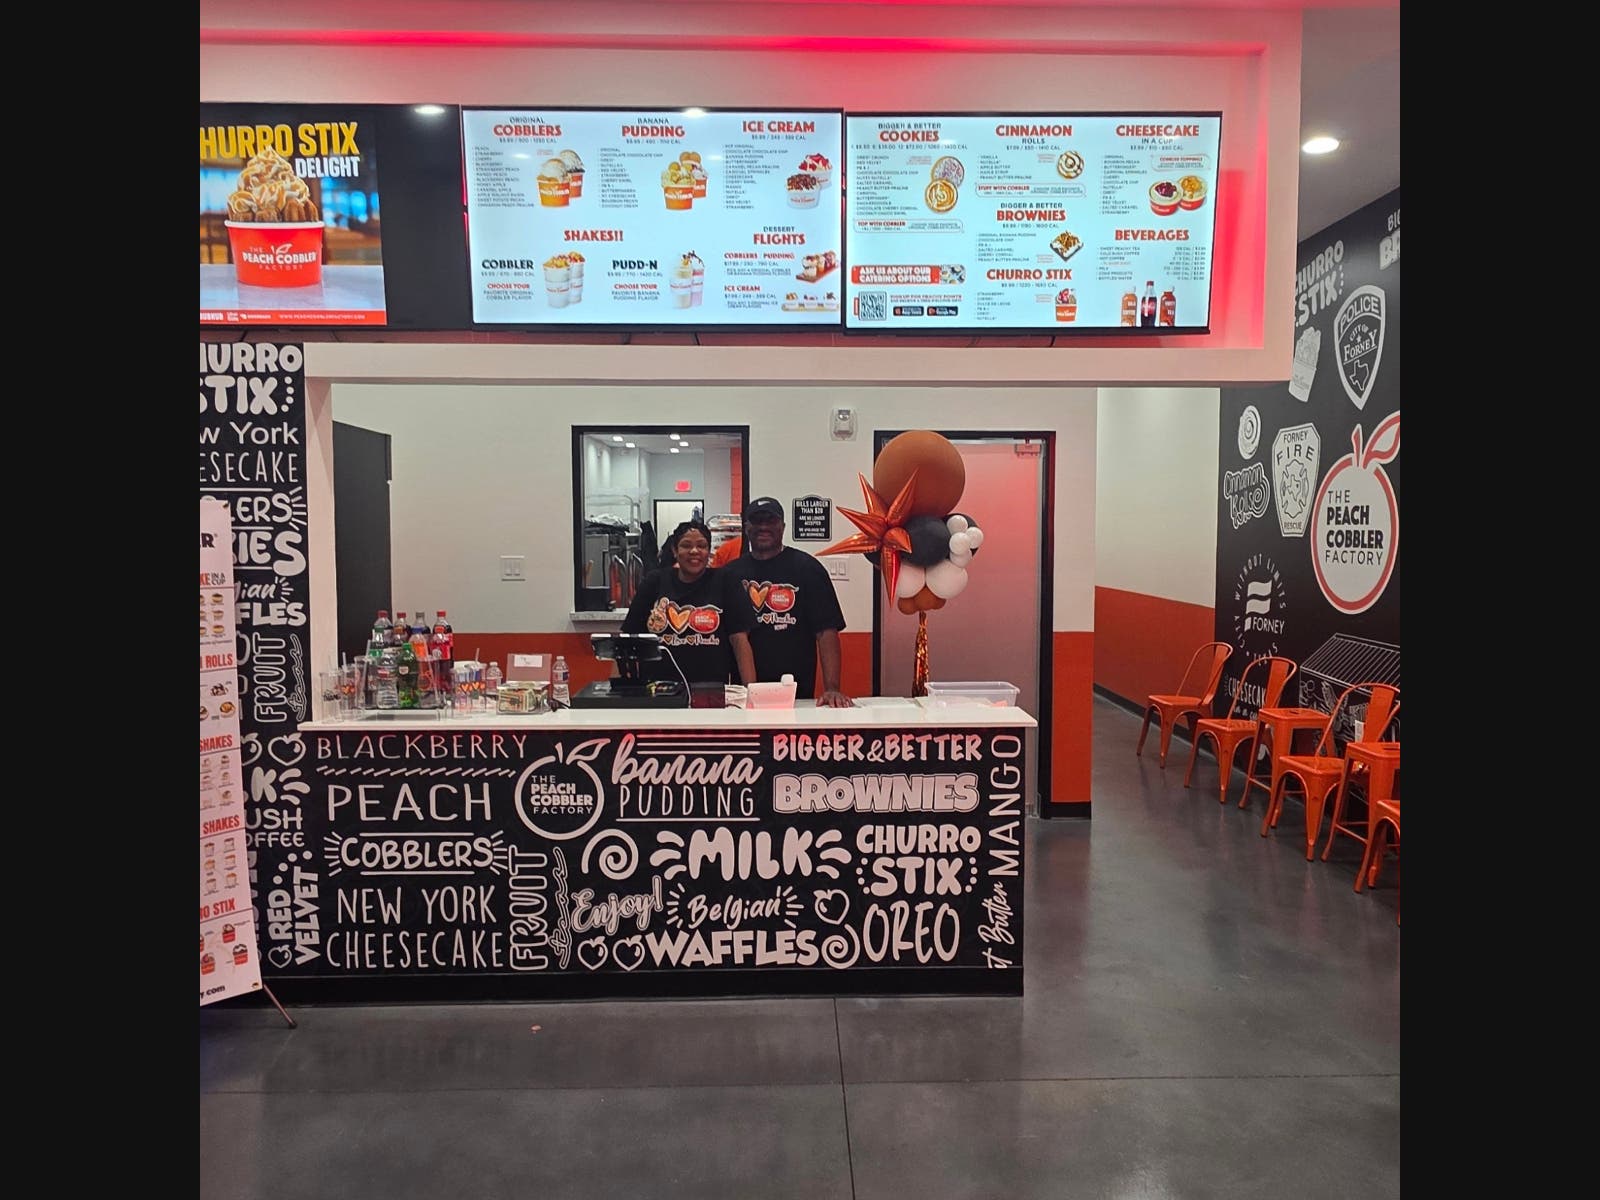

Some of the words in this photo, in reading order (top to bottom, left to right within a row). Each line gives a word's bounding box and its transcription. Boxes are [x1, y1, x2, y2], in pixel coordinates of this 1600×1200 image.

[493, 124, 563, 137] COBBLERS
[509, 116, 546, 124] ORIGINAL
[637, 118, 670, 126] BANANA
[743, 120, 765, 133] ICE
[768, 121, 815, 133] CREAM
[1116, 124, 1200, 137] CHEESECAKE
[298, 121, 360, 157] STIX
[621, 126, 686, 138] PUDDING
[880, 130, 940, 142] COOKIES
[995, 125, 1073, 137] CINNAMON
[1021, 137, 1046, 145] ROLLS
[295, 156, 361, 178] DELIGHT
[996, 210, 1066, 222] BROWNIES
[563, 230, 624, 242] SHAKES!!
[753, 234, 806, 245] FLIGHTS
[1115, 229, 1190, 241] BEVERAGES
[242, 251, 274, 264] PEACH
[276, 250, 317, 264] COBBLER
[481, 259, 534, 270] COBBLER
[1295, 240, 1345, 294] HURRO
[859, 266, 875, 275] ASK
[876, 266, 886, 275] US
[887, 266, 913, 275] ABOUT
[914, 266, 931, 275] OUR
[859, 275, 897, 284] CATERING
[898, 275, 931, 284] OPTIONS
[986, 269, 1043, 281] CHURRO
[1045, 269, 1072, 281] STIX
[1298, 271, 1338, 326] STIX
[1340, 295, 1380, 334] POLICE
[1343, 329, 1378, 362] FORNEY
[229, 421, 300, 445] York
[1283, 430, 1308, 444] FORNEY
[1277, 444, 1315, 469] FIRE
[1328, 489, 1351, 504] THE
[1283, 520, 1303, 531] RESCUE
[1326, 505, 1370, 526] PEACH
[1326, 529, 1384, 550] COBBLER
[1325, 549, 1383, 565] FACTORY
[1252, 616, 1285, 635] FORNEY
[206, 653, 234, 670] ROLLS
[253, 631, 287, 723] FRUIT
[200, 734, 233, 753] SHAKES
[317, 734, 527, 760] BLACKBERRY
[611, 733, 764, 786] banana
[530, 783, 576, 795] PEACH
[531, 774, 556, 783] THE
[327, 782, 492, 821] PEACH
[530, 794, 594, 806] COBBLER
[619, 785, 755, 818] PUDDING
[773, 773, 981, 814] BROWNIES
[533, 806, 594, 815] FACTORY
[987, 733, 1022, 877] MANGO
[203, 814, 240, 836] SHAKES
[856, 823, 982, 855] CHURRO
[341, 837, 494, 869] COBBLERS
[688, 825, 813, 882] MILK
[870, 855, 964, 897] STIX
[213, 898, 236, 917] STIX
[267, 889, 293, 941] RED
[337, 886, 402, 925] NEW
[421, 885, 497, 925] YORK
[508, 844, 549, 971] FRUIT
[570, 874, 664, 936] Enjoy!
[687, 893, 782, 931] Belgian
[293, 866, 321, 966] VELVET
[862, 899, 961, 964] OREO
[326, 929, 504, 969] CHEESECAKE
[645, 929, 820, 967] WAFFLES
